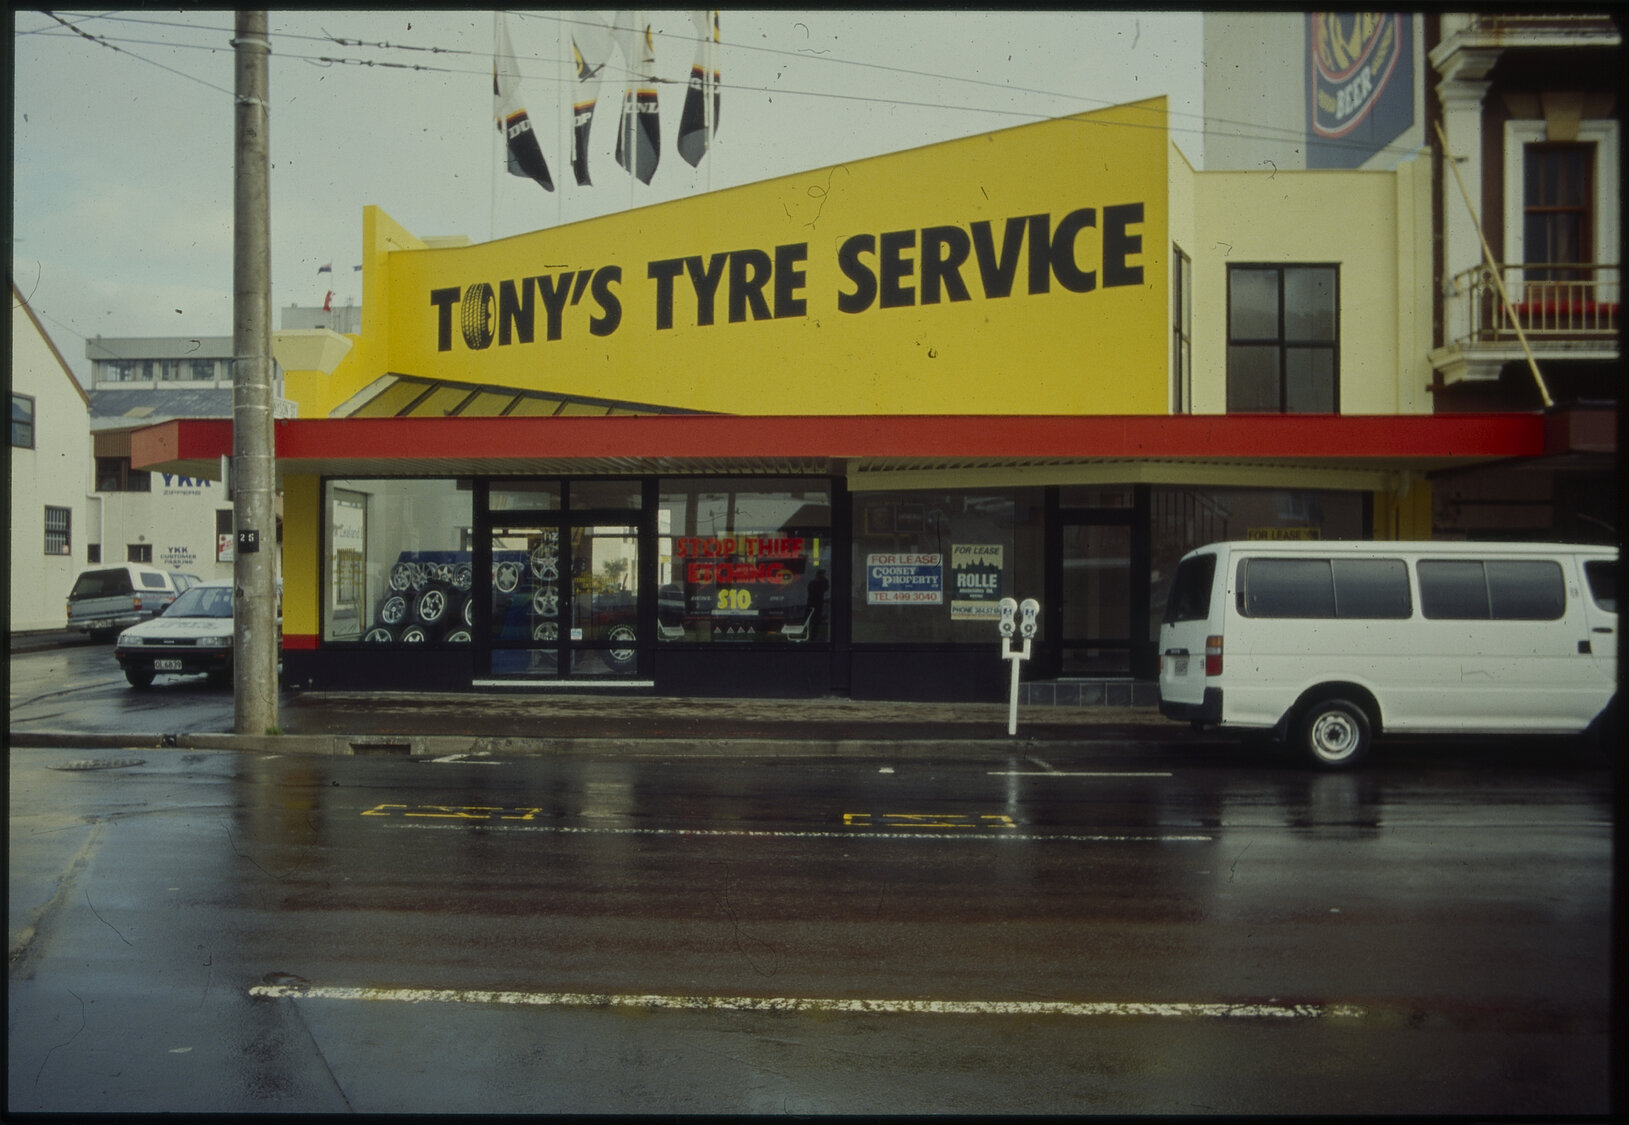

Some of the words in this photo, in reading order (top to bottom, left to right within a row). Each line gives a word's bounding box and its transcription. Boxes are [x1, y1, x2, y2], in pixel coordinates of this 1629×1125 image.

[1336, 66, 1372, 120] BEER
[430, 265, 622, 352] TONY'S
[647, 242, 808, 330] TYRE
[838, 202, 1145, 314] SERVICE
[677, 538, 737, 559] STOP
[744, 538, 804, 558] THIEF
[974, 547, 1000, 555] LEASE
[871, 556, 896, 564] FOR
[899, 556, 938, 564] LEASE
[687, 563, 784, 584] ETCHING
[872, 567, 916, 579] COONEY
[882, 575, 939, 588] PROPERTY
[957, 574, 998, 588] ROLLE
